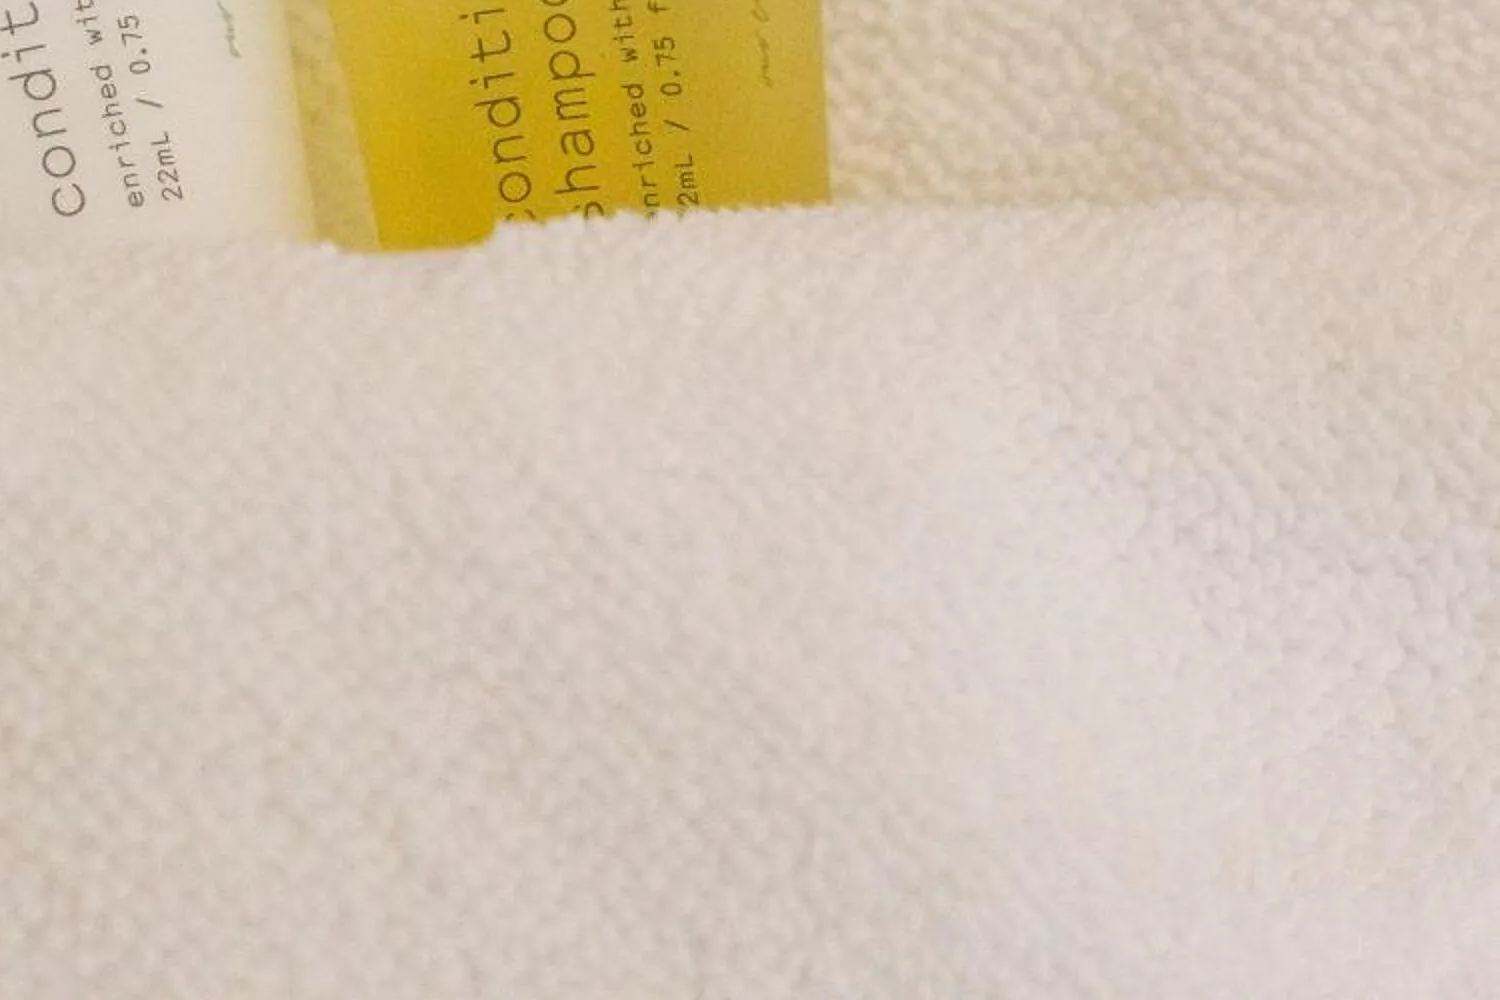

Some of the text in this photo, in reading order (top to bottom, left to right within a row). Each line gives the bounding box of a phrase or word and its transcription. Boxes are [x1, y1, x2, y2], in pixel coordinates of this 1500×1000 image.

[117, 15, 151, 74] 0.75
[652, 36, 683, 96] 0.75
[136, 98, 163, 108] /
[664, 119, 689, 131] /
[89, 64, 145, 208] enriched
[151, 132, 183, 201] 22mL
[621, 83, 660, 221] nriched
[674, 154, 700, 220] 2mL
